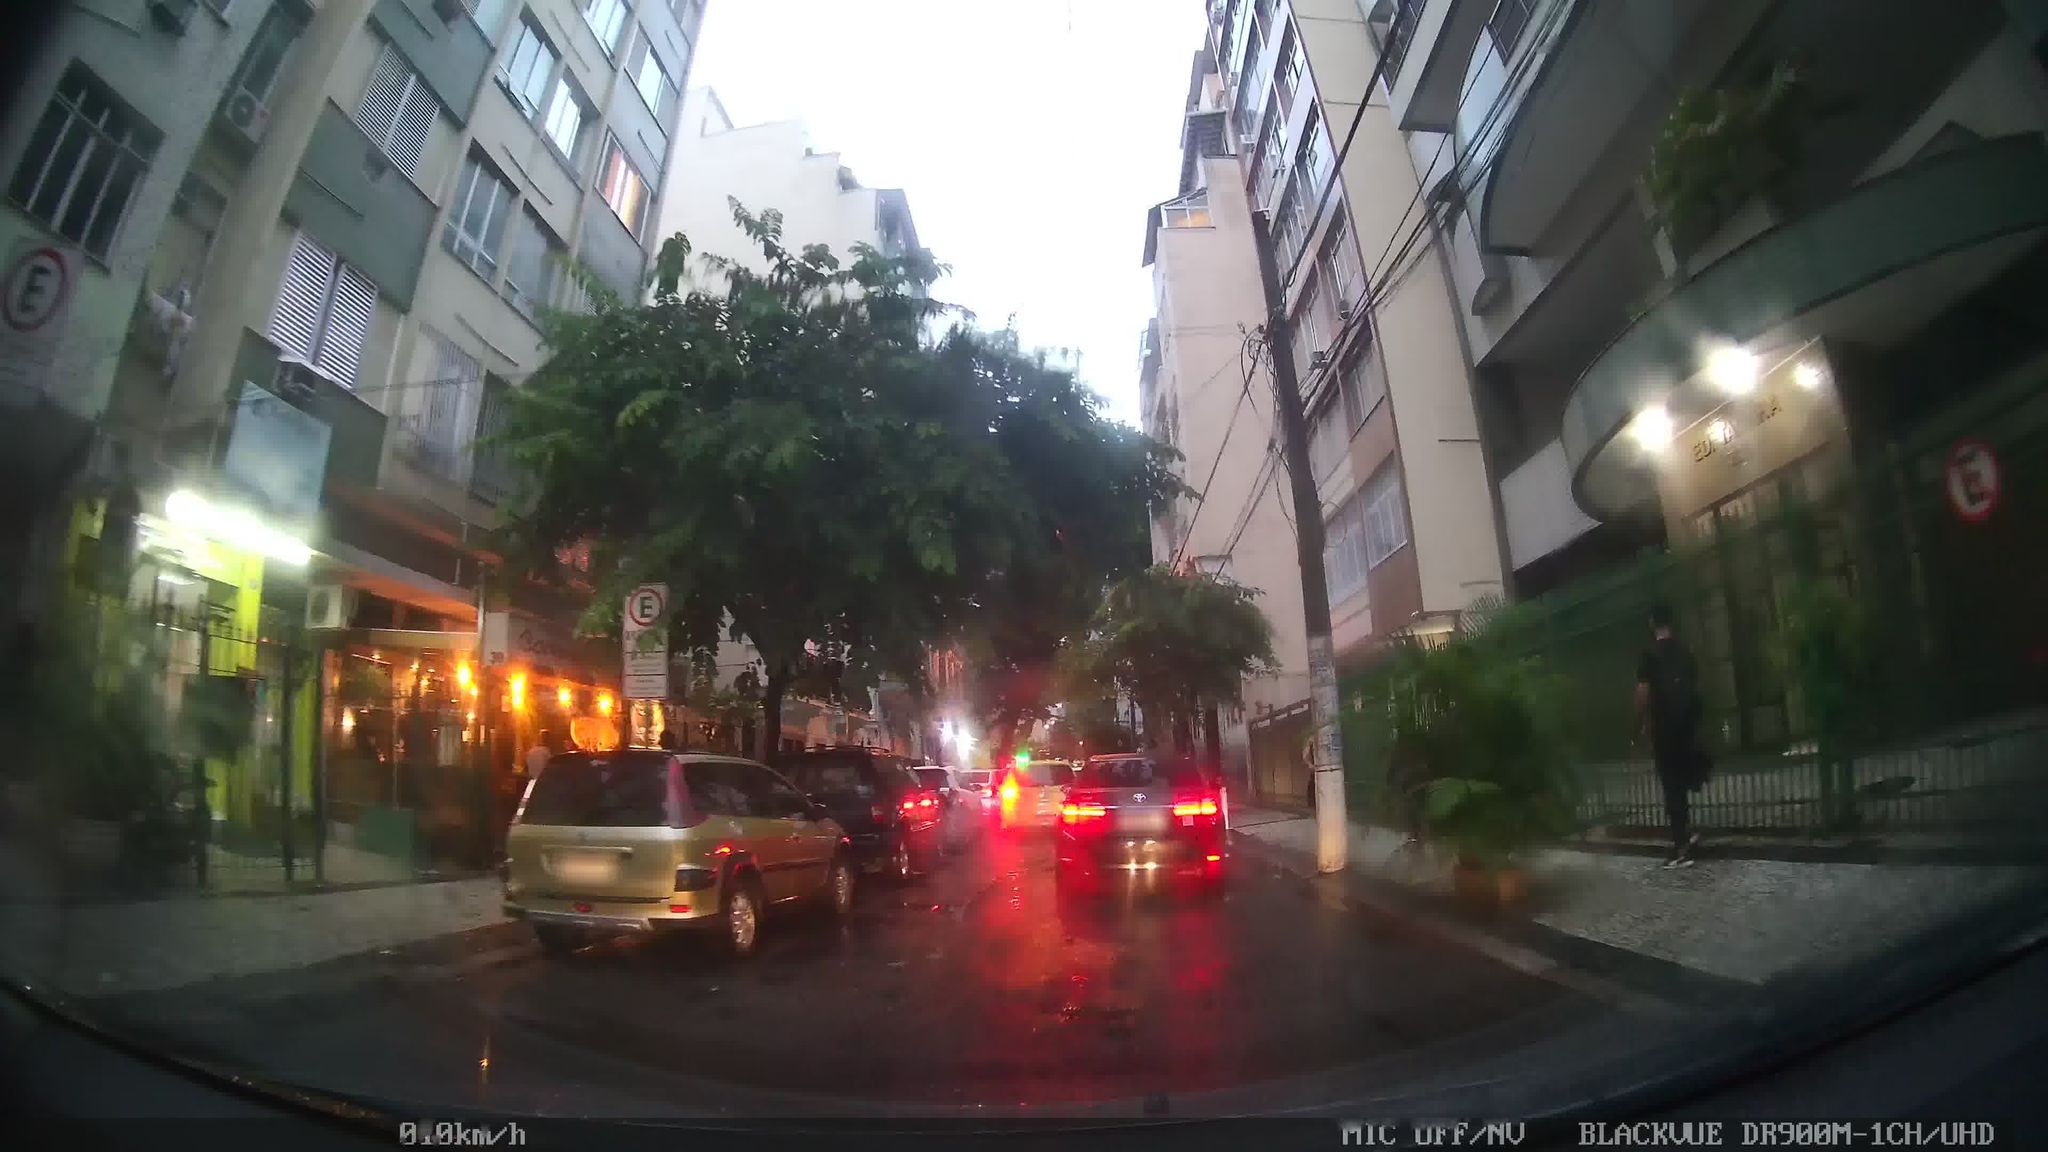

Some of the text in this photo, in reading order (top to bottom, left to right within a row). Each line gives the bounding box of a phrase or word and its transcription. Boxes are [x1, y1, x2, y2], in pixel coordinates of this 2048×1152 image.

[19, 265, 50, 313] E
[1954, 449, 1985, 507] E
[639, 596, 653, 618] E
